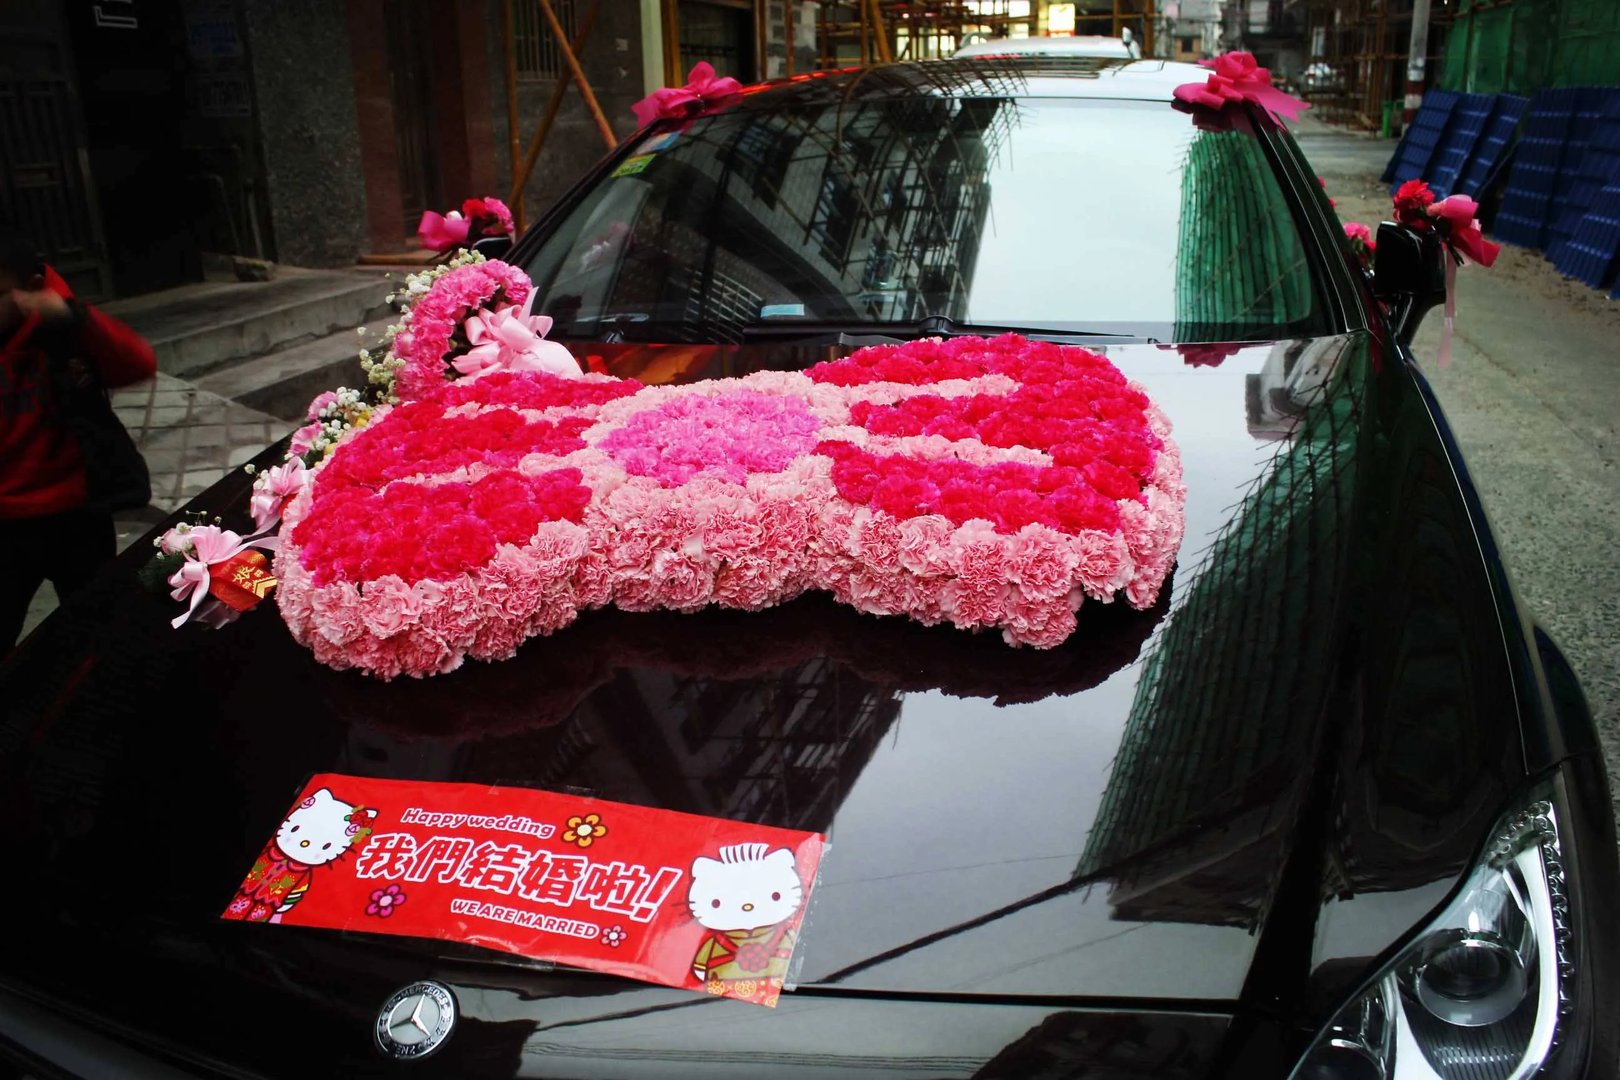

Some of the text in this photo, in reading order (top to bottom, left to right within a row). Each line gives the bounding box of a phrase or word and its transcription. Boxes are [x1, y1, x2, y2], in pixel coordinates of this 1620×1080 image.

[401, 808, 556, 839] Happy wedding
[451, 899, 600, 939] WE ARE MARRIED
